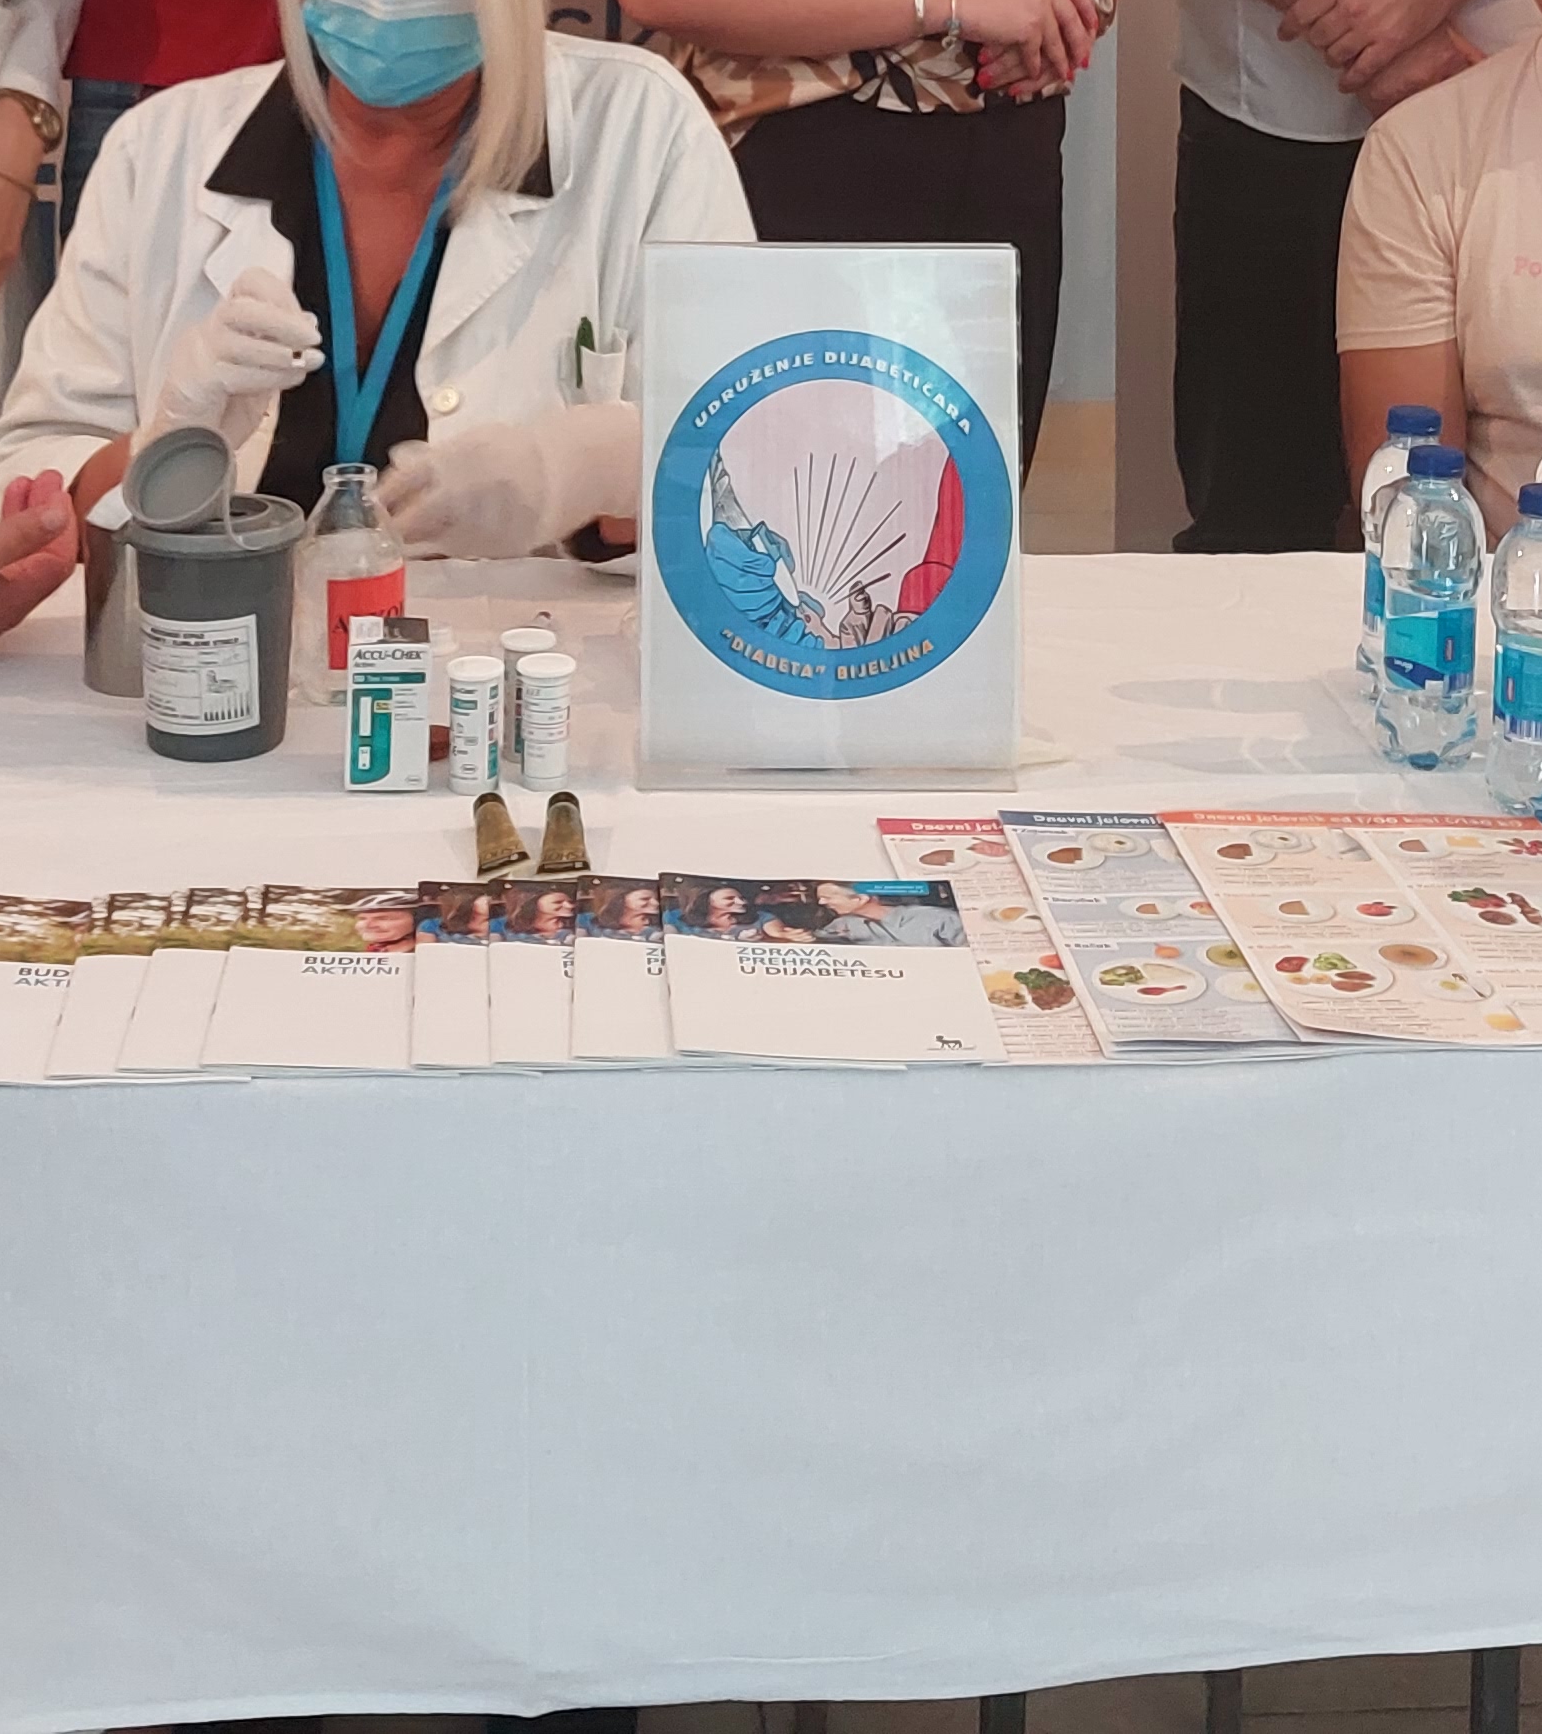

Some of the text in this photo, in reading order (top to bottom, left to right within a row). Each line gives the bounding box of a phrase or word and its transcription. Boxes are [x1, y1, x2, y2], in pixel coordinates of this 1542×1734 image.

[694, 350, 972, 436] UDRUŽENJE DIJABETIČARA
[352, 648, 423, 661] ACCU-CHEK
[835, 639, 935, 680] BIJELJINA
[736, 946, 832, 958] ZDRAVA
[302, 955, 390, 967] BUDITE
[738, 956, 868, 968] PREHRANA
[300, 965, 401, 976] AKTIVNI
[739, 966, 905, 979] U DIJABETESU
